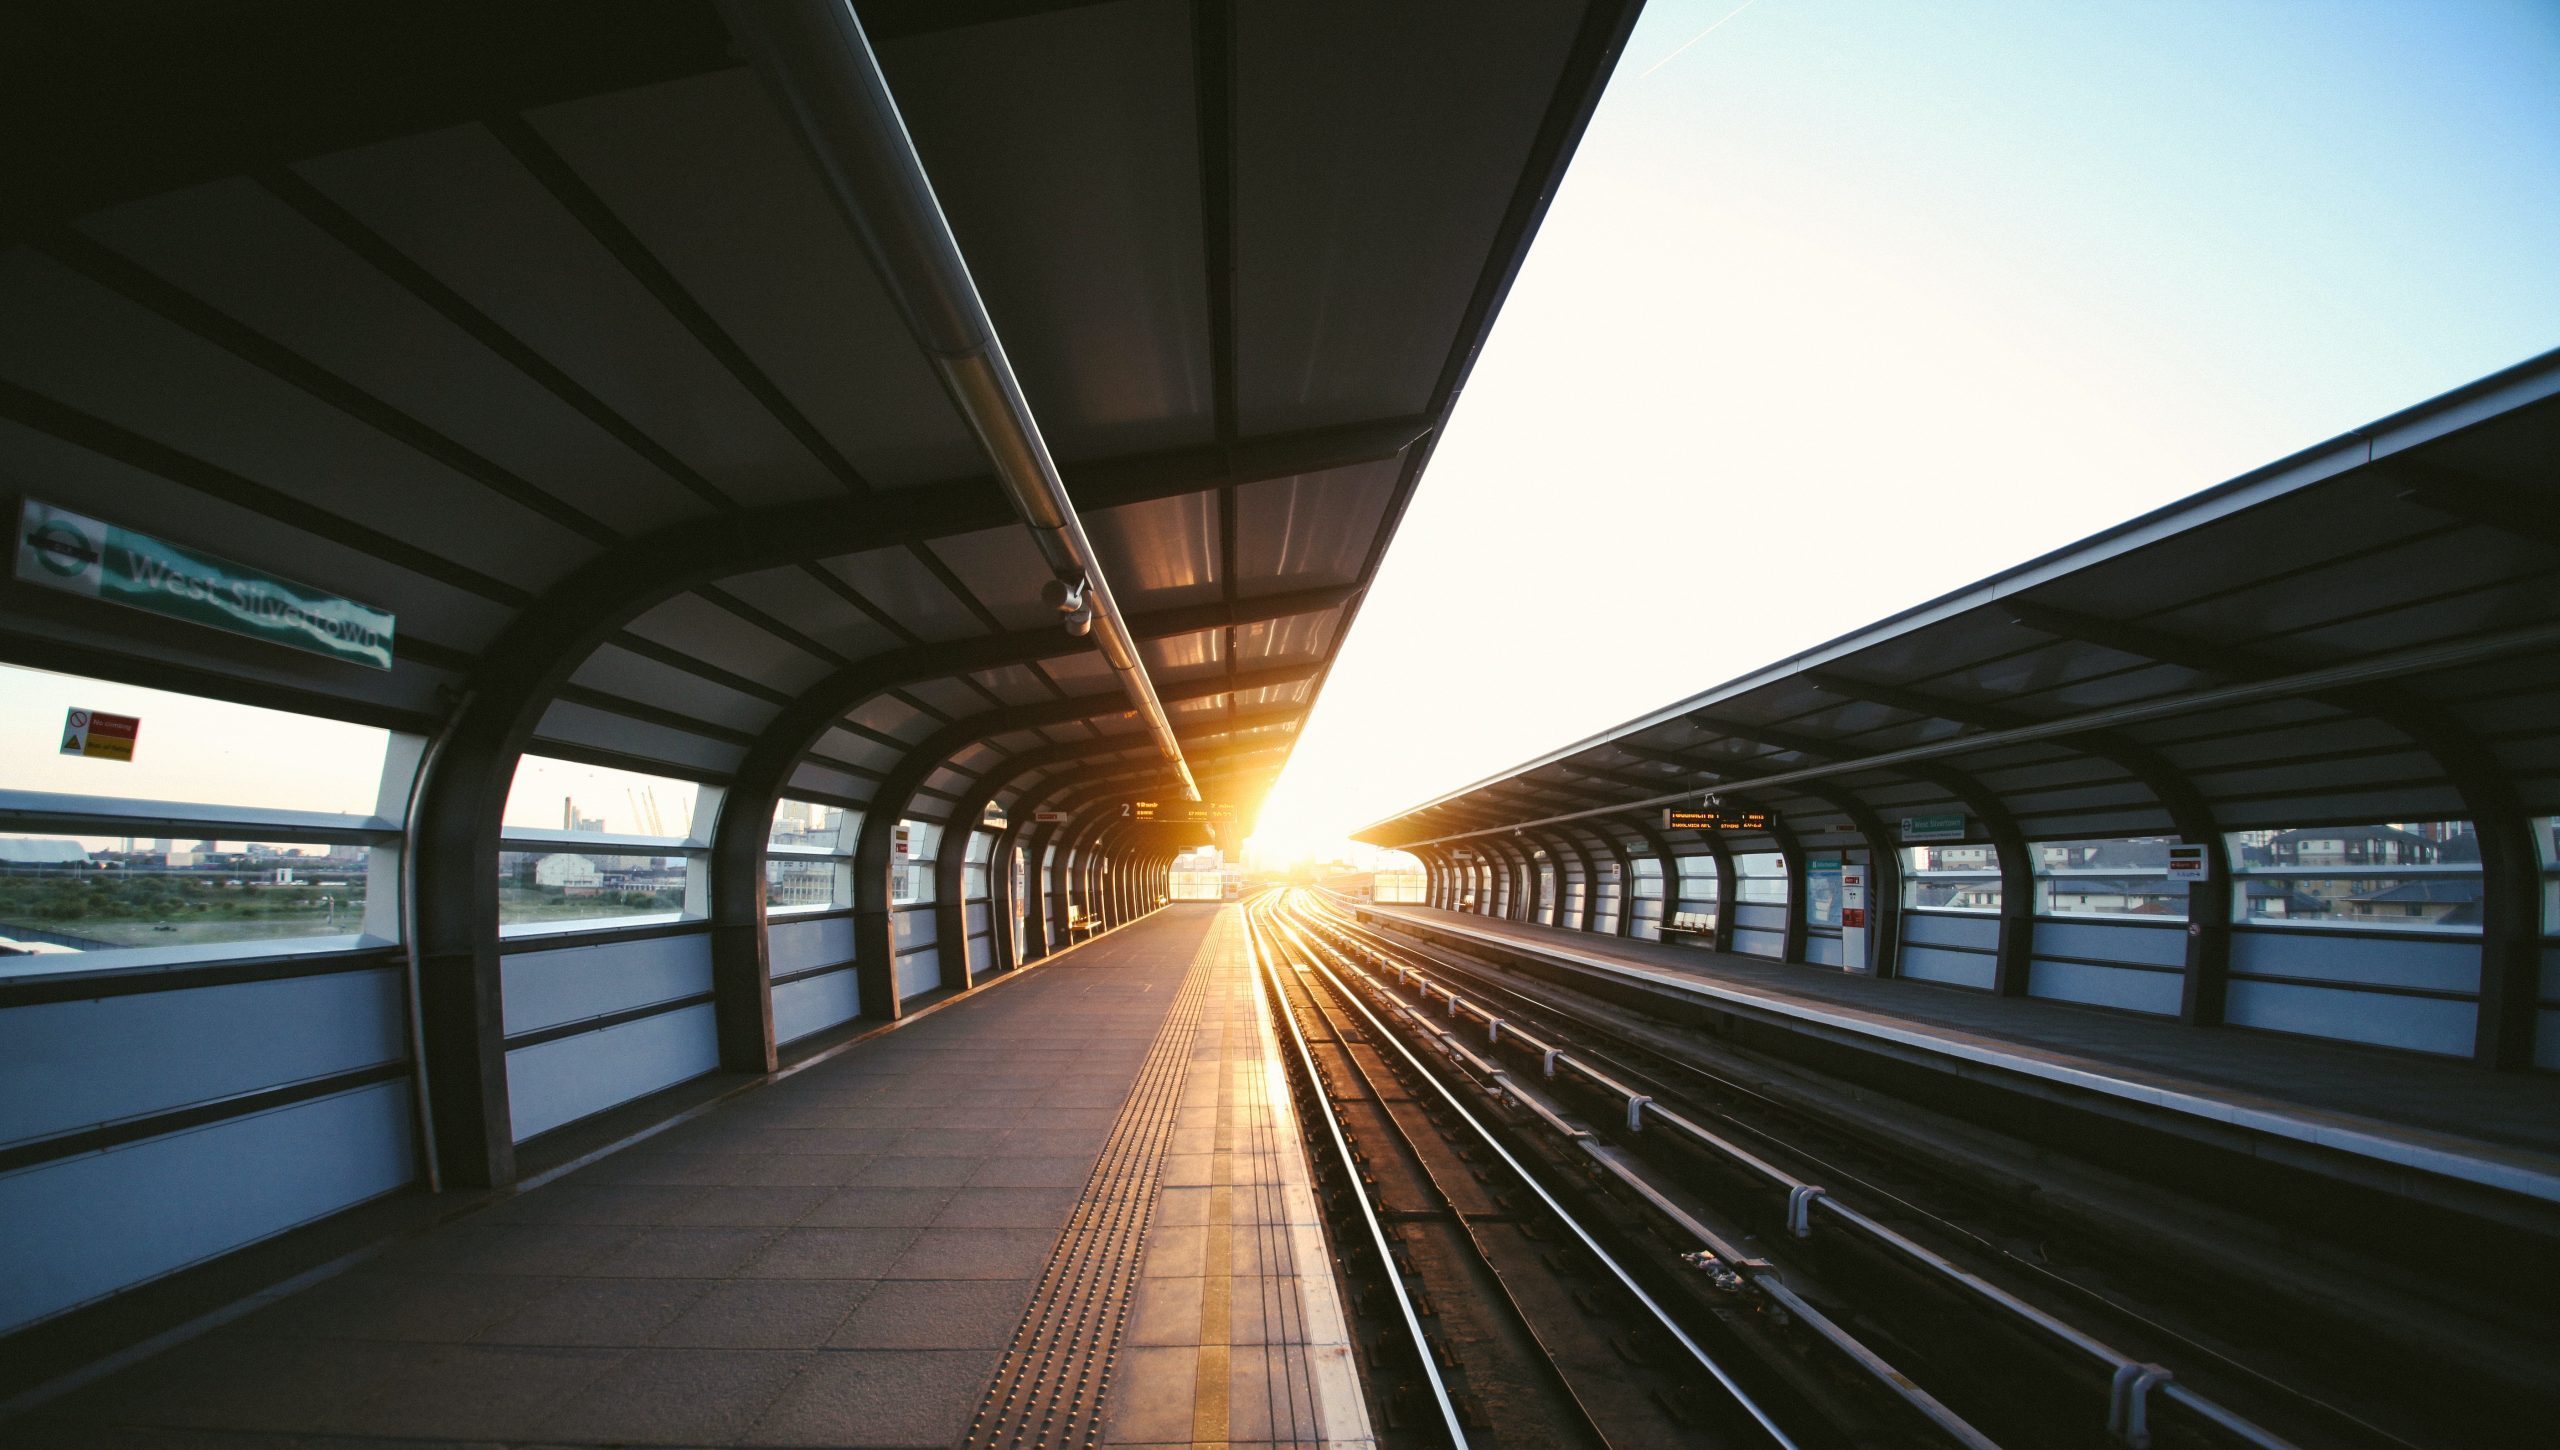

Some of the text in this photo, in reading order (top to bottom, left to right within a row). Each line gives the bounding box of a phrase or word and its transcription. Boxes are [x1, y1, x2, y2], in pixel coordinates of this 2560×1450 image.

[127, 549, 381, 649] West Silvertown
[1121, 803, 1130, 817] 2
